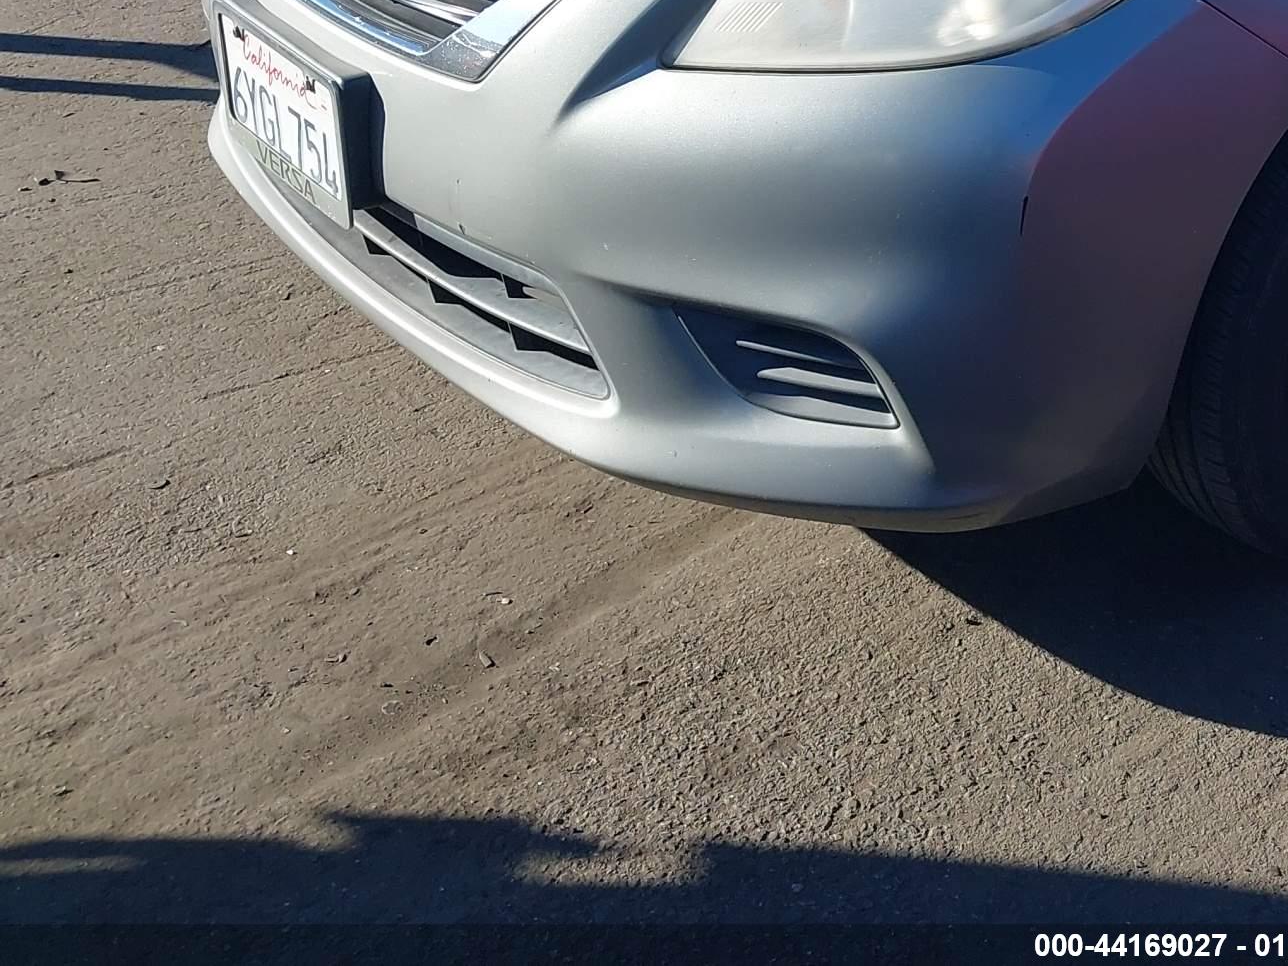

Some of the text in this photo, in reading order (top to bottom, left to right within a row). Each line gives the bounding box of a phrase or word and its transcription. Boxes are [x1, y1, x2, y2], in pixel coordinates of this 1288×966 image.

[243, 34, 316, 110] California
[233, 66, 339, 196] 6YGL754
[255, 139, 318, 205] VERSA
